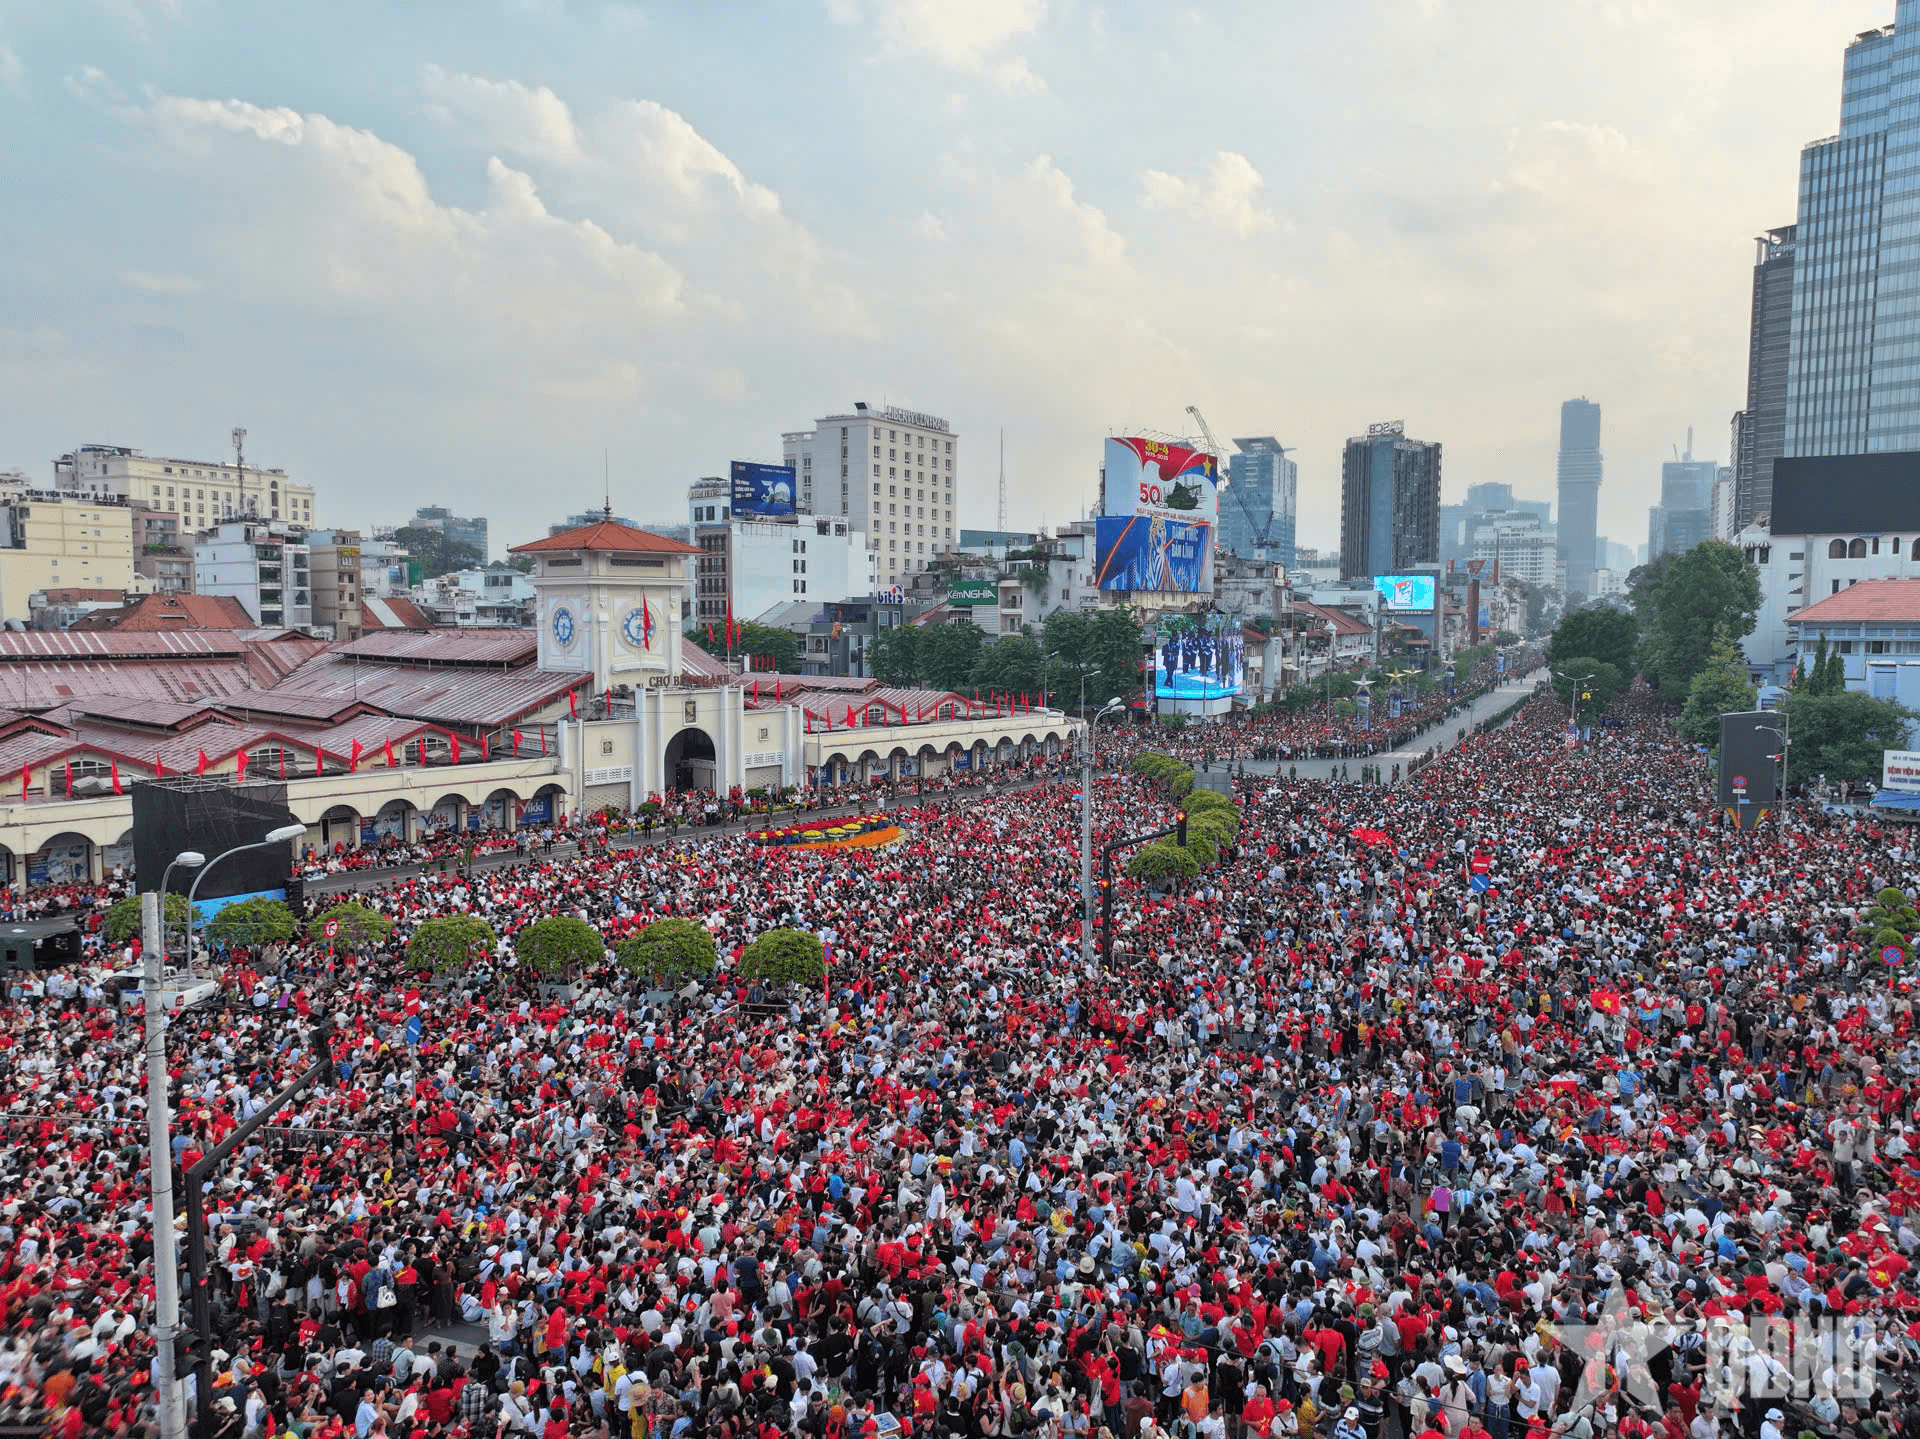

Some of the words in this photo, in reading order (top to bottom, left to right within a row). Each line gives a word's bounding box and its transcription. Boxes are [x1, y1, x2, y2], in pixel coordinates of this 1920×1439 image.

[886, 405, 915, 425] LIBERTY
[1145, 440, 1169, 455] 30-4
[45, 490, 60, 498] VIỆN
[1139, 482, 1161, 506] 50
[520, 800, 544, 813] Vikki
[421, 812, 448, 825] Vikki
